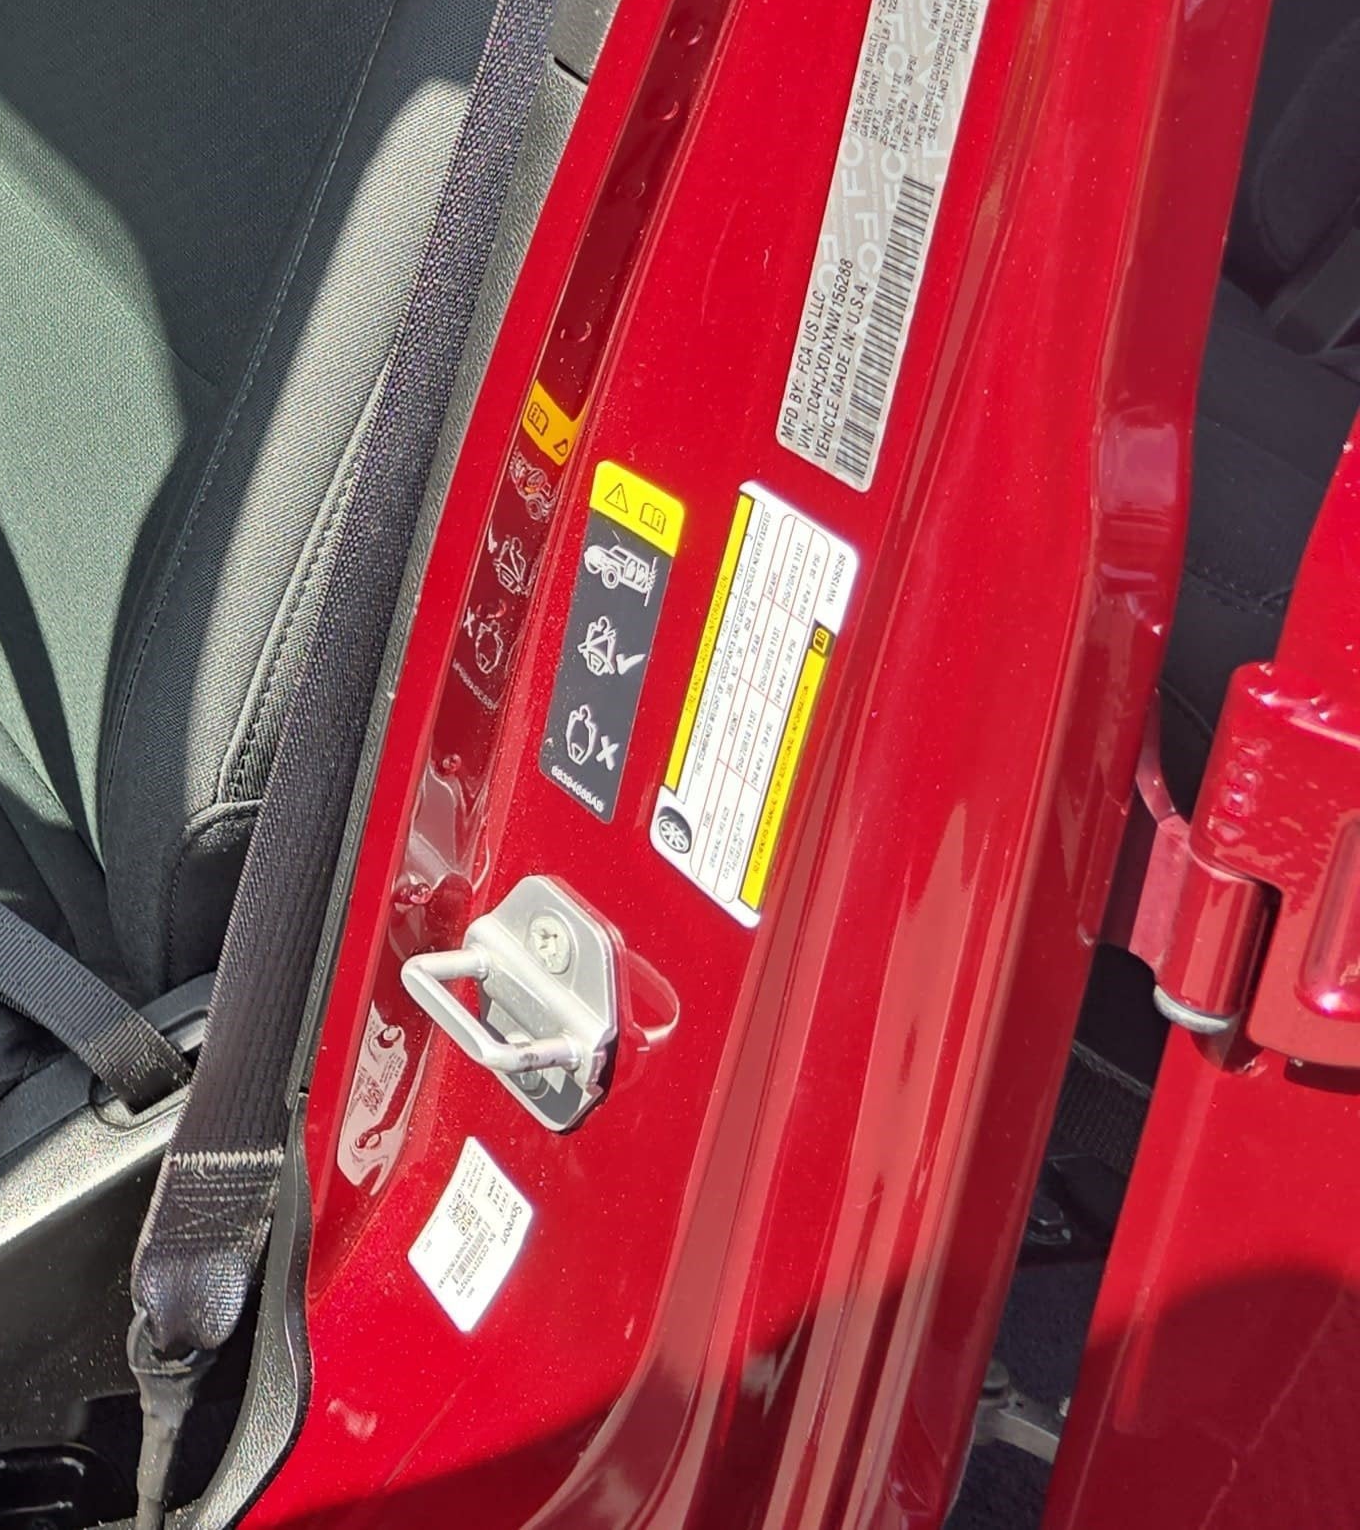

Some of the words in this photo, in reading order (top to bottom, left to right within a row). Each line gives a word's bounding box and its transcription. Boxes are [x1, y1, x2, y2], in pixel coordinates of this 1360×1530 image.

[941, 44, 956, 75] THEFT
[859, 69, 870, 90] MFR
[859, 108, 873, 137] GAWR
[876, 41, 887, 65] 2700
[914, 124, 926, 147] THIS
[921, 84, 936, 122] VEHICLE
[929, 27, 950, 81] CONFORMS
[942, 11, 953, 23] TO
[936, 78, 948, 100] AND
[855, 93, 864, 105] OF
[889, 136, 897, 150] AT
[906, 54, 916, 71] PSI
[851, 109, 862, 132] DATE
[927, 102, 940, 139] SAFETY
[807, 289, 825, 318] LLC
[846, 282, 868, 325] U.S.A.
[803, 319, 819, 342] US
[839, 328, 856, 351] IN:
[795, 345, 813, 374] FCA
[797, 419, 815, 449] VIN:
[806, 257, 853, 415] 1C4HJXDNXNW156288
[829, 351, 850, 398] MADE
[788, 378, 805, 404] BY:
[780, 406, 798, 440] MFD
[813, 397, 839, 459] VEHICLE
